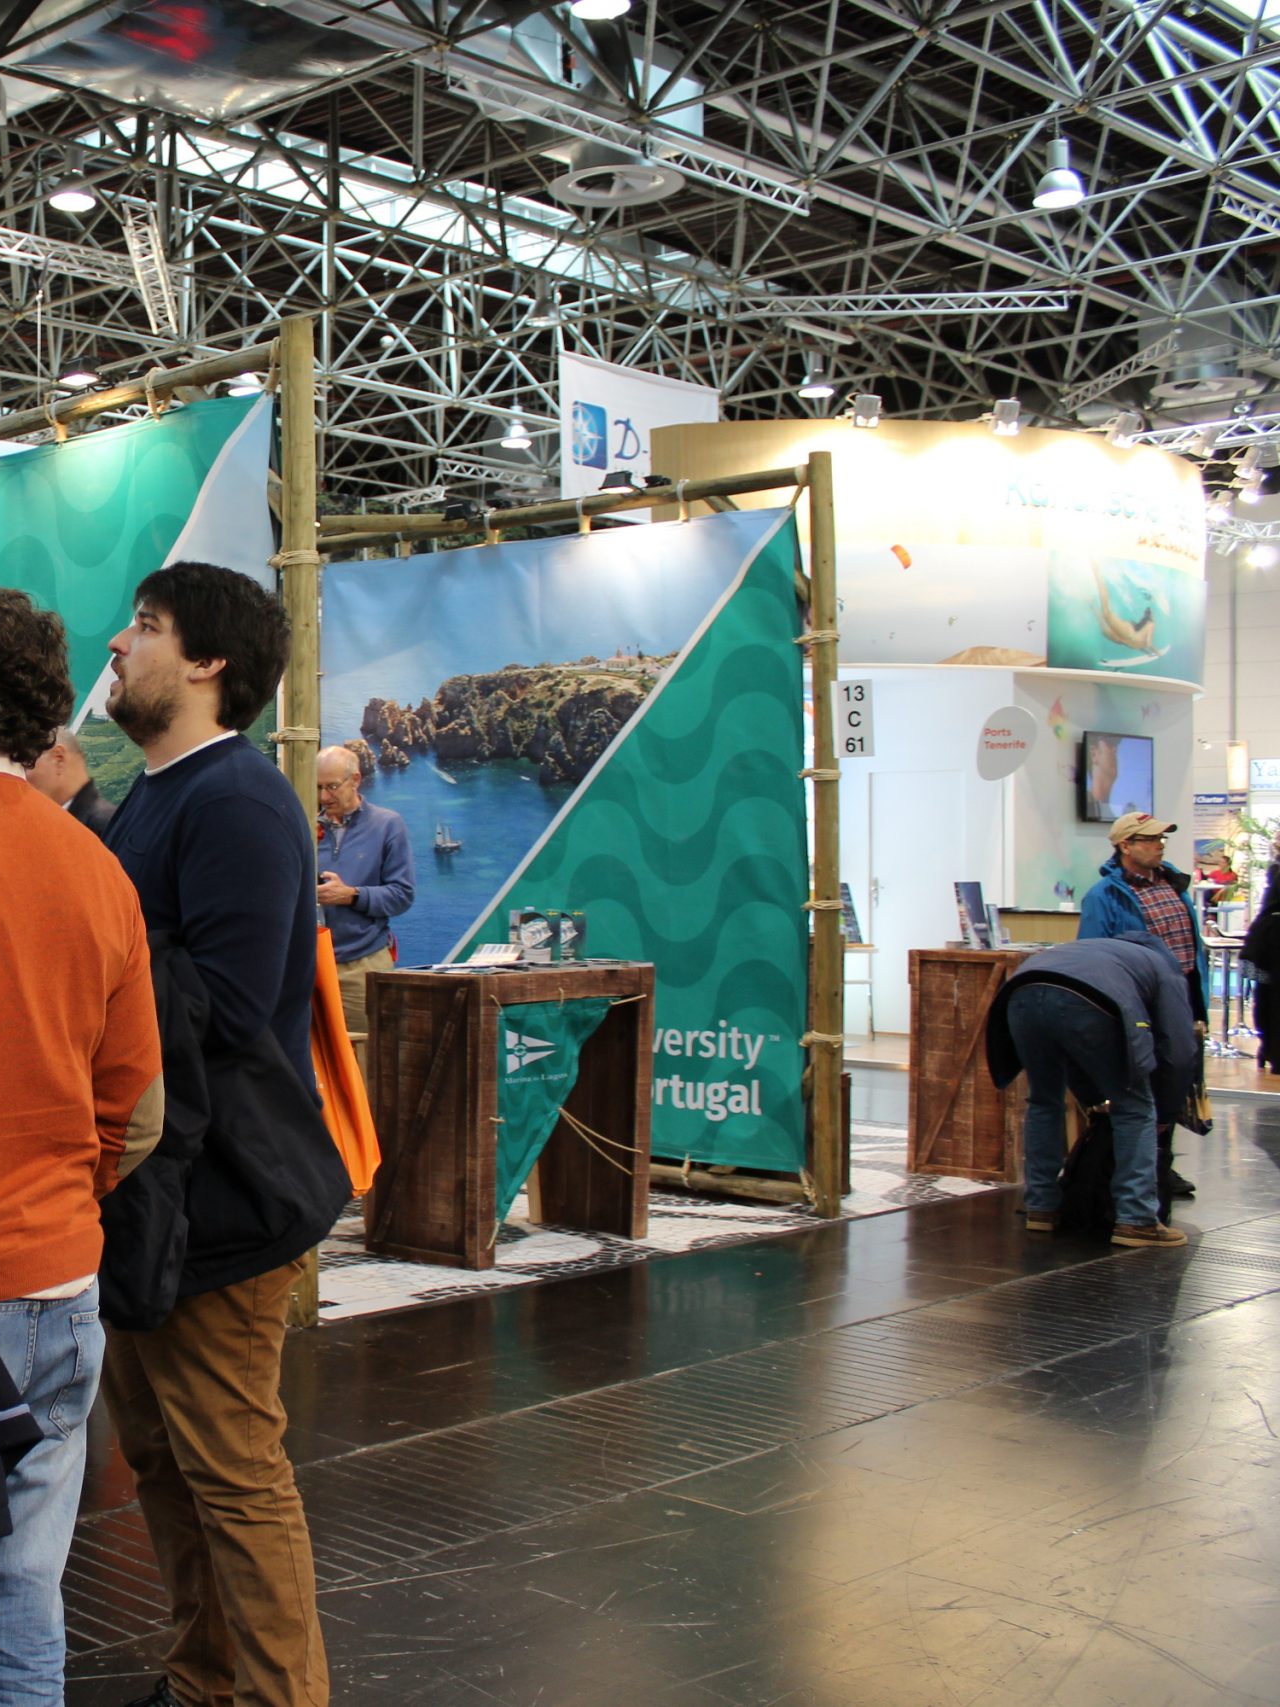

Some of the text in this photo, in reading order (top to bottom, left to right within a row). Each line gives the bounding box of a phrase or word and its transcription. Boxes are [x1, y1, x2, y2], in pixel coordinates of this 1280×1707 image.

[843, 684, 865, 702] 13
[847, 710, 862, 728] C
[983, 727, 1013, 737] Ports
[845, 736, 865, 753] 61
[984, 740, 1026, 750] Tenerife
[1196, 795, 1225, 804] Charter
[651, 1074, 762, 1122] rtugal
